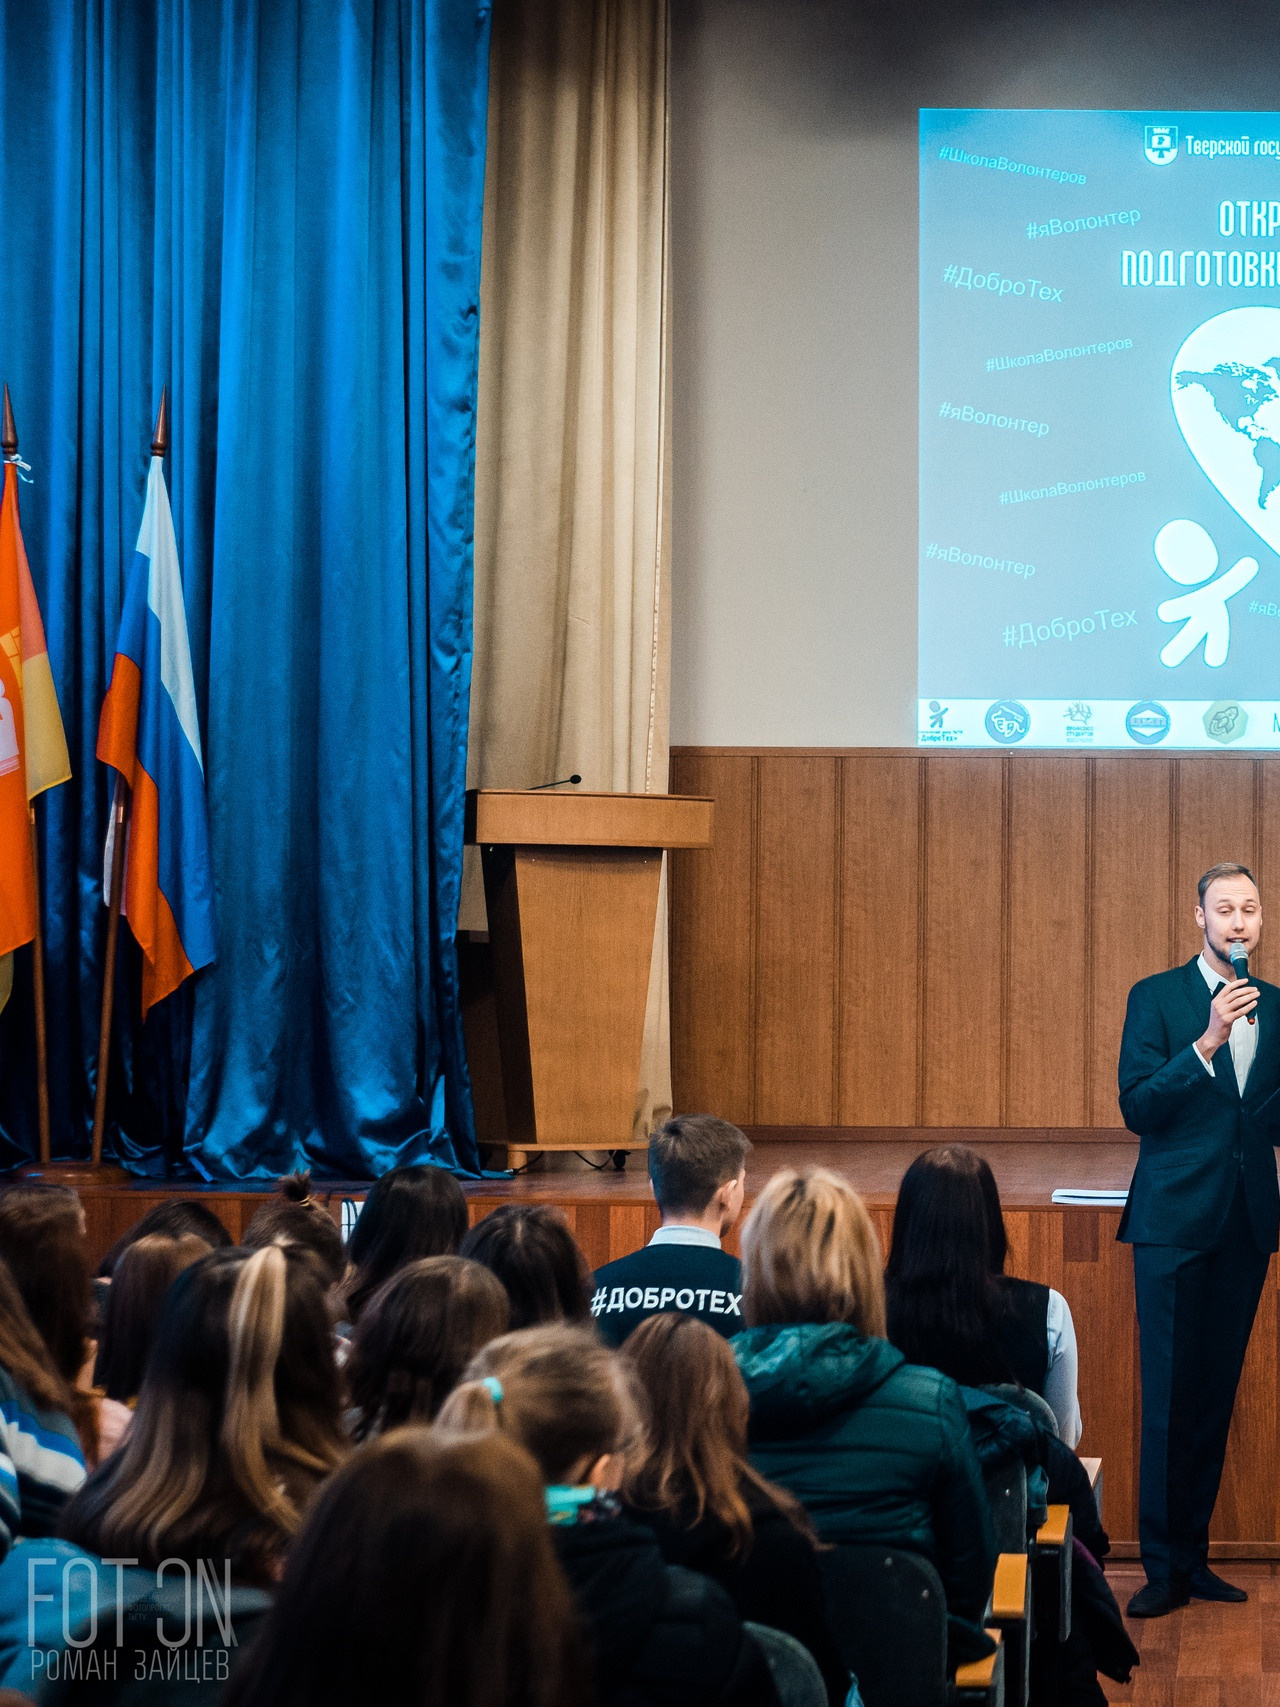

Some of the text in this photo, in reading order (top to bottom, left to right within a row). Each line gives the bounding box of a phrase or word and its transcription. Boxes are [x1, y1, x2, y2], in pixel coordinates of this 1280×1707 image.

[1186, 135, 1250, 160] Тверской
[939, 146, 1087, 186] #ШколаВолонтеров
[1026, 207, 1141, 240] #яВолонтер
[943, 264, 1064, 302] #ДоброТех
[986, 336, 1134, 372] #ШколаВолонтеров
[938, 402, 1050, 438] #яВолонтер
[999, 471, 1146, 505] #ШколаВолонтеров
[926, 542, 1036, 579] #яВолонтер
[1002, 608, 1138, 649] #ДоброТех
[590, 1286, 743, 1317] #ДОБРОТЕХ
